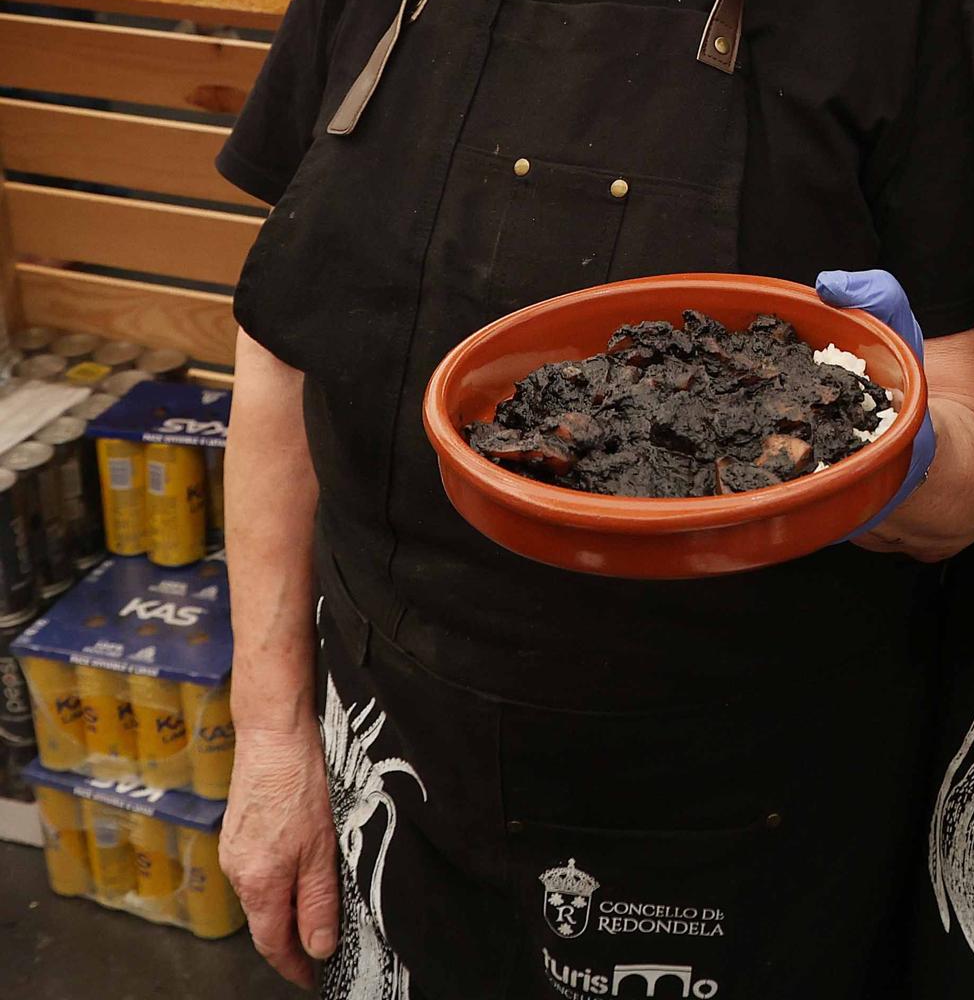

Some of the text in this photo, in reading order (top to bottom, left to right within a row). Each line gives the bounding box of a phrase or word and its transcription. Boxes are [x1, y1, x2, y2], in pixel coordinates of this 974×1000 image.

[119, 597, 208, 627] KAS
[599, 901, 725, 921] CONCELLO DE
[597, 915, 725, 937] REDONDELA
